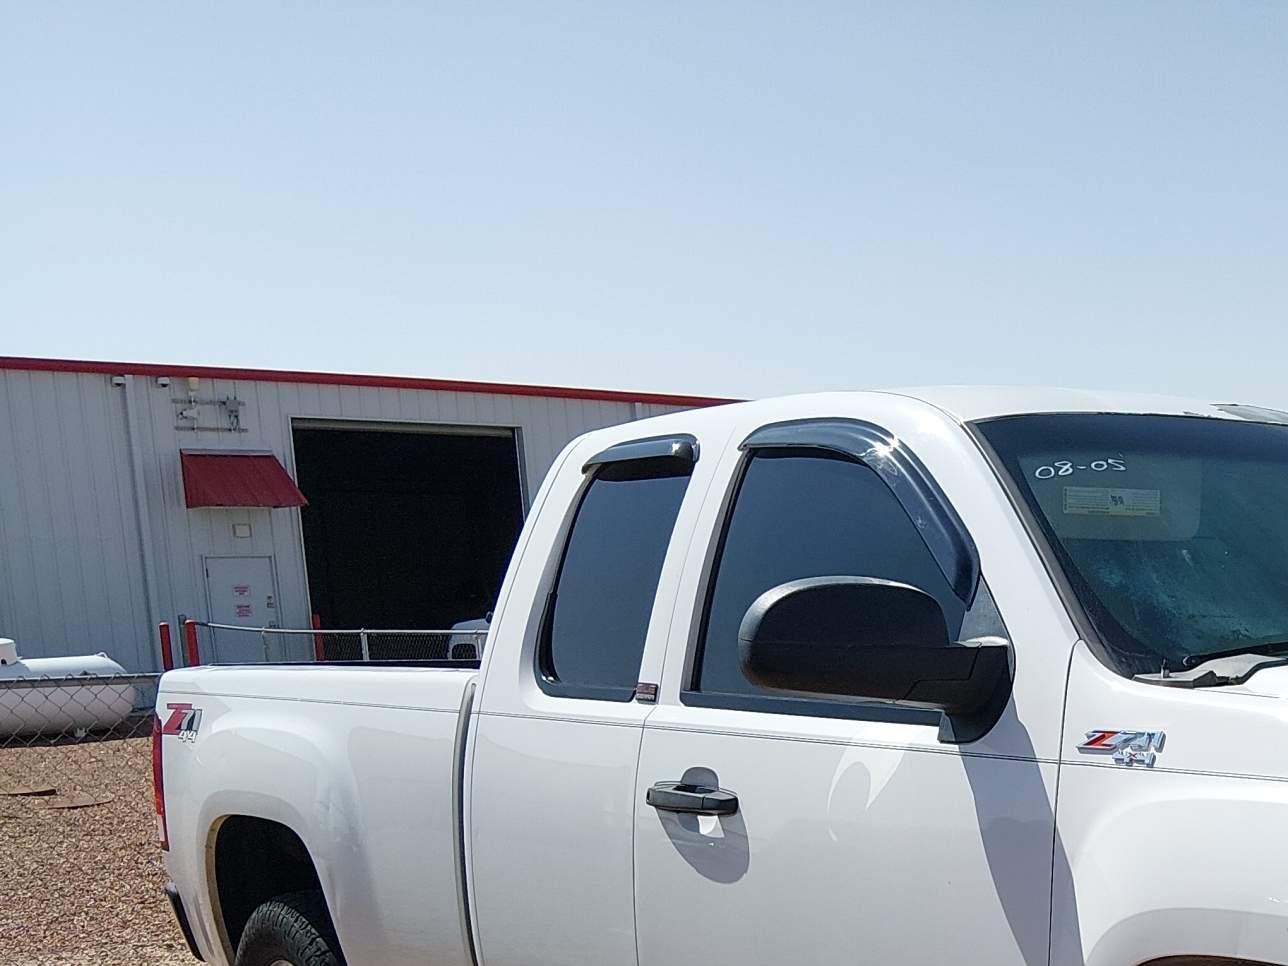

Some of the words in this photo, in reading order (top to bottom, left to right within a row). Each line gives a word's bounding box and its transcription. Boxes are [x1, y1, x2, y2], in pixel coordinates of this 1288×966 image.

[1035, 457, 1127, 479] 08-05
[162, 703, 203, 736] Z71
[1076, 730, 1166, 756] Z71
